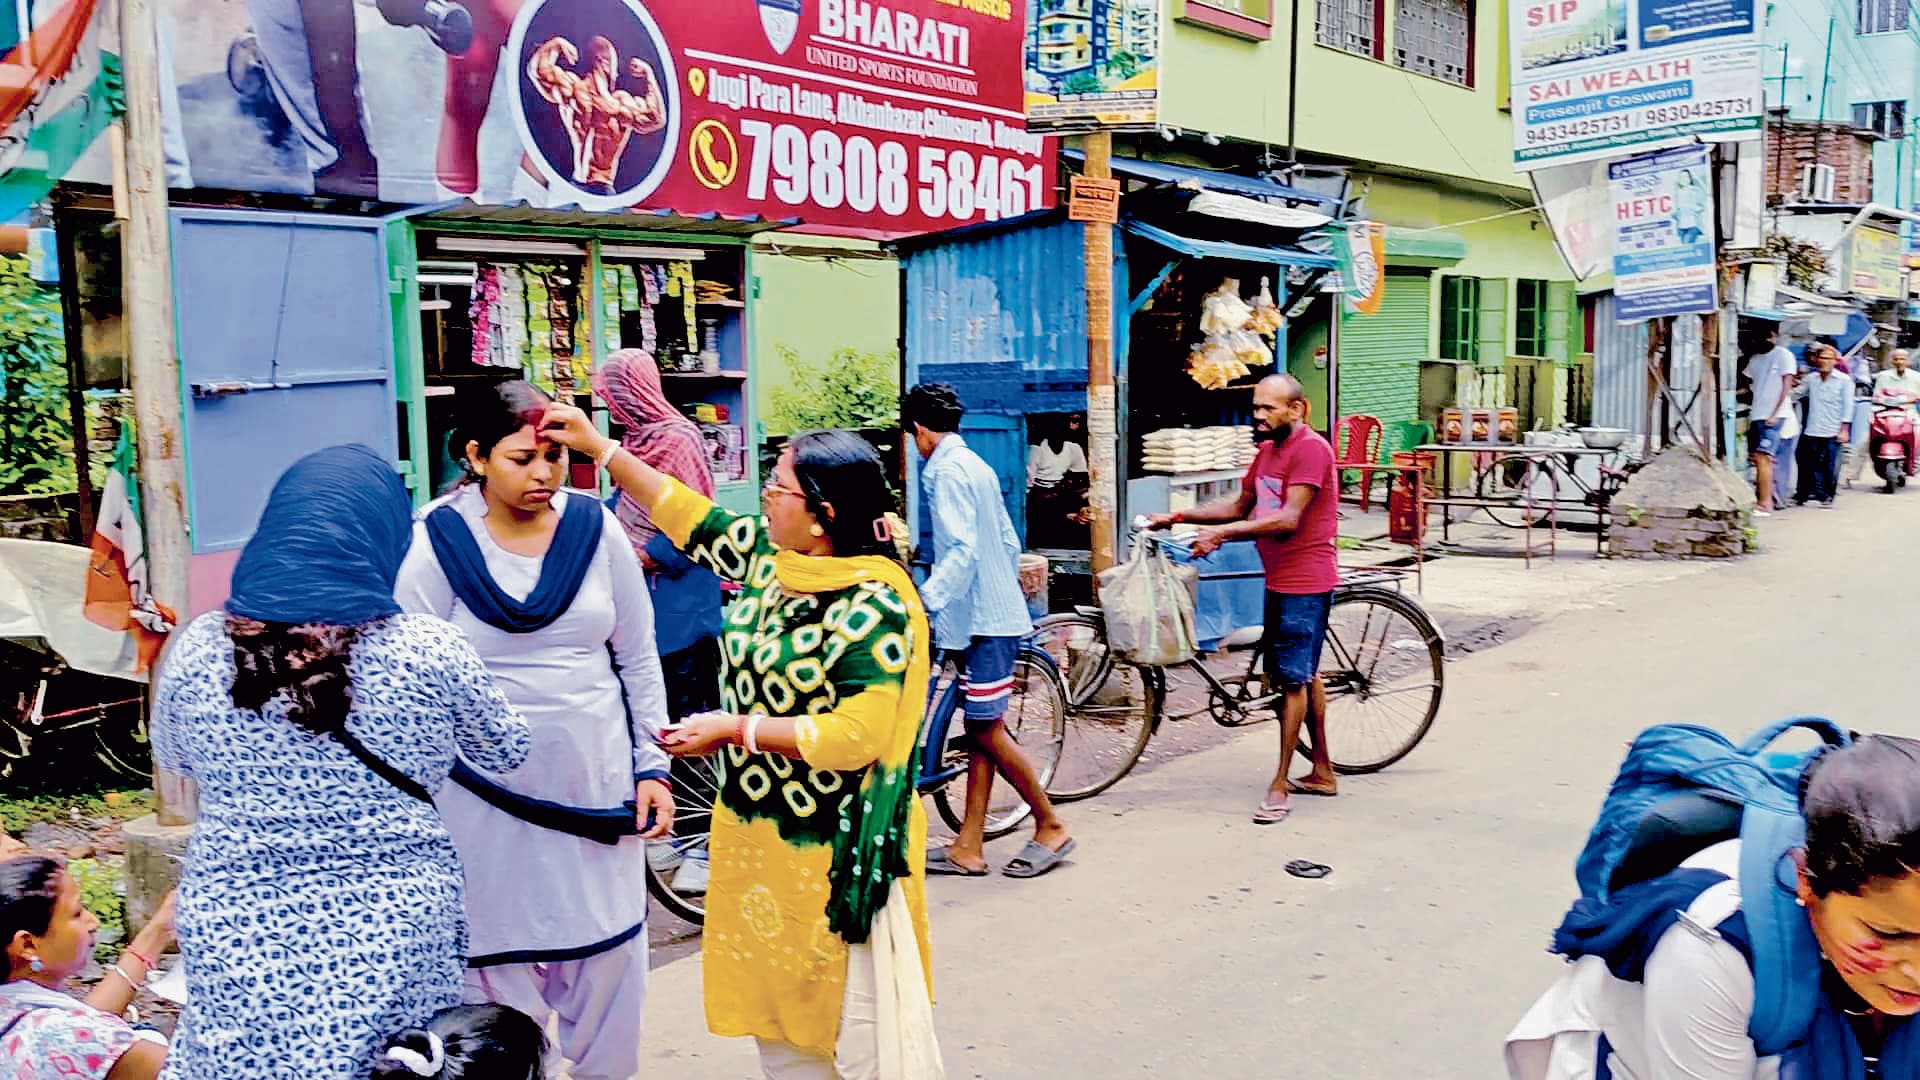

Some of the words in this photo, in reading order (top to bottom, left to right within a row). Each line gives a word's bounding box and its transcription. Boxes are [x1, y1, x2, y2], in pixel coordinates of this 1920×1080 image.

[818, 0, 969, 67] BHARATI
[1527, 0, 1577, 27] SIP
[805, 46, 858, 73] UNITED
[858, 57, 905, 82] SPORTS
[905, 67, 978, 97] FOUNDATION
[1529, 80, 1571, 102] SAI
[1583, 58, 1691, 92] WEALTH
[748, 75, 791, 114] Para
[792, 83, 836, 125] Lane,
[1527, 98, 1603, 121] Prasenjit
[1606, 83, 1689, 108] Goswami
[1527, 114, 1630, 145] 9433425731
[1646, 97, 1752, 125] 9830425731
[740, 118, 909, 217] 79808
[918, 145, 1043, 222] 58461
[1617, 196, 1672, 220] HETC
